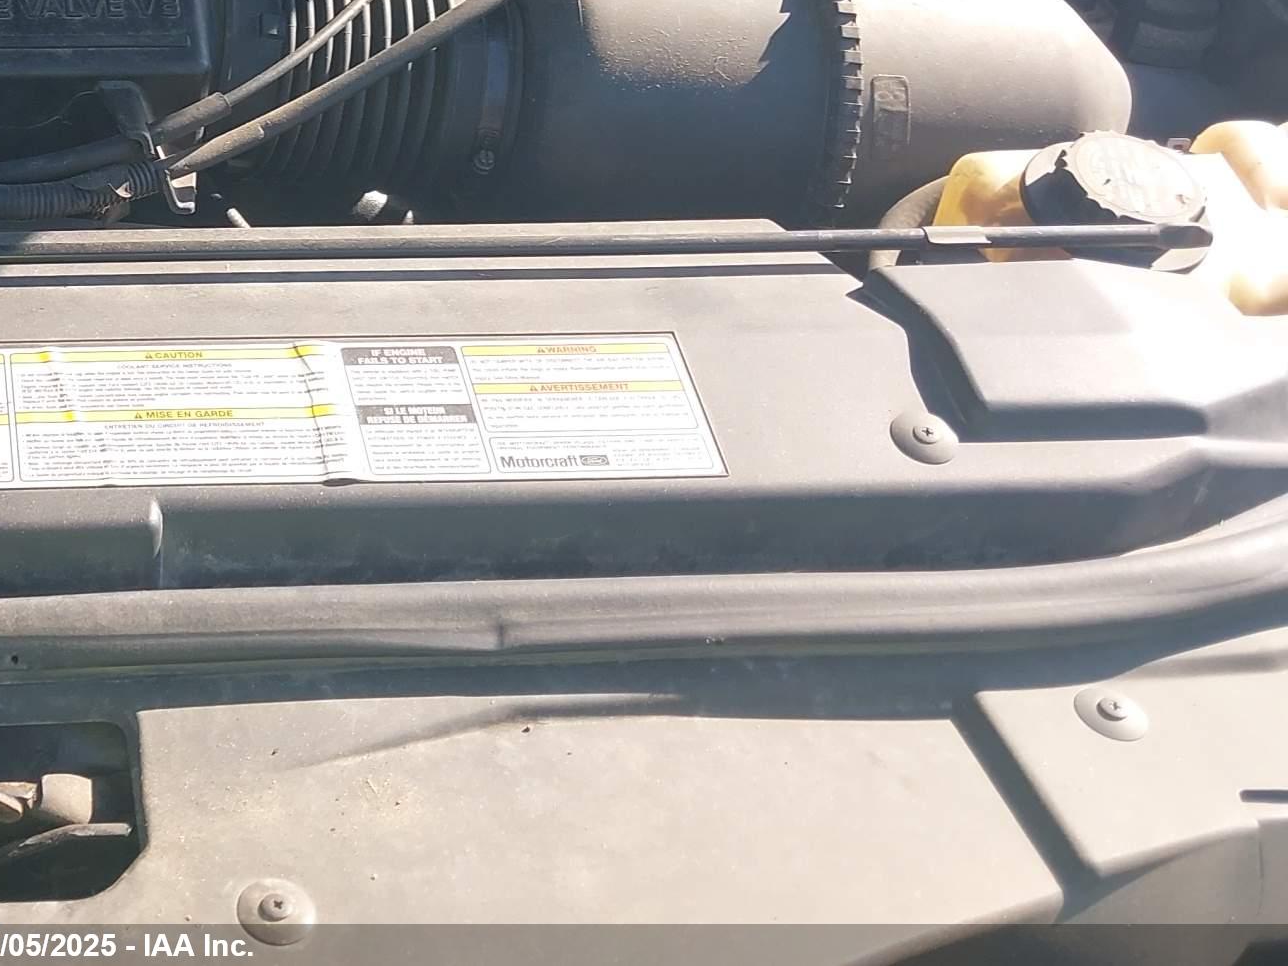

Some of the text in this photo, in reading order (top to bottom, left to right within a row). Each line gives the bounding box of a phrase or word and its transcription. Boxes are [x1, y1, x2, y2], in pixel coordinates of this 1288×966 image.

[155, 351, 203, 359] CAUTION
[383, 348, 426, 356] ENGINE
[408, 356, 443, 364] START
[540, 383, 630, 392] AVERTISSEMENT
[146, 409, 233, 419] MISE EN GARDE
[395, 407, 407, 415] LE
[500, 455, 580, 468] Motorcraft
